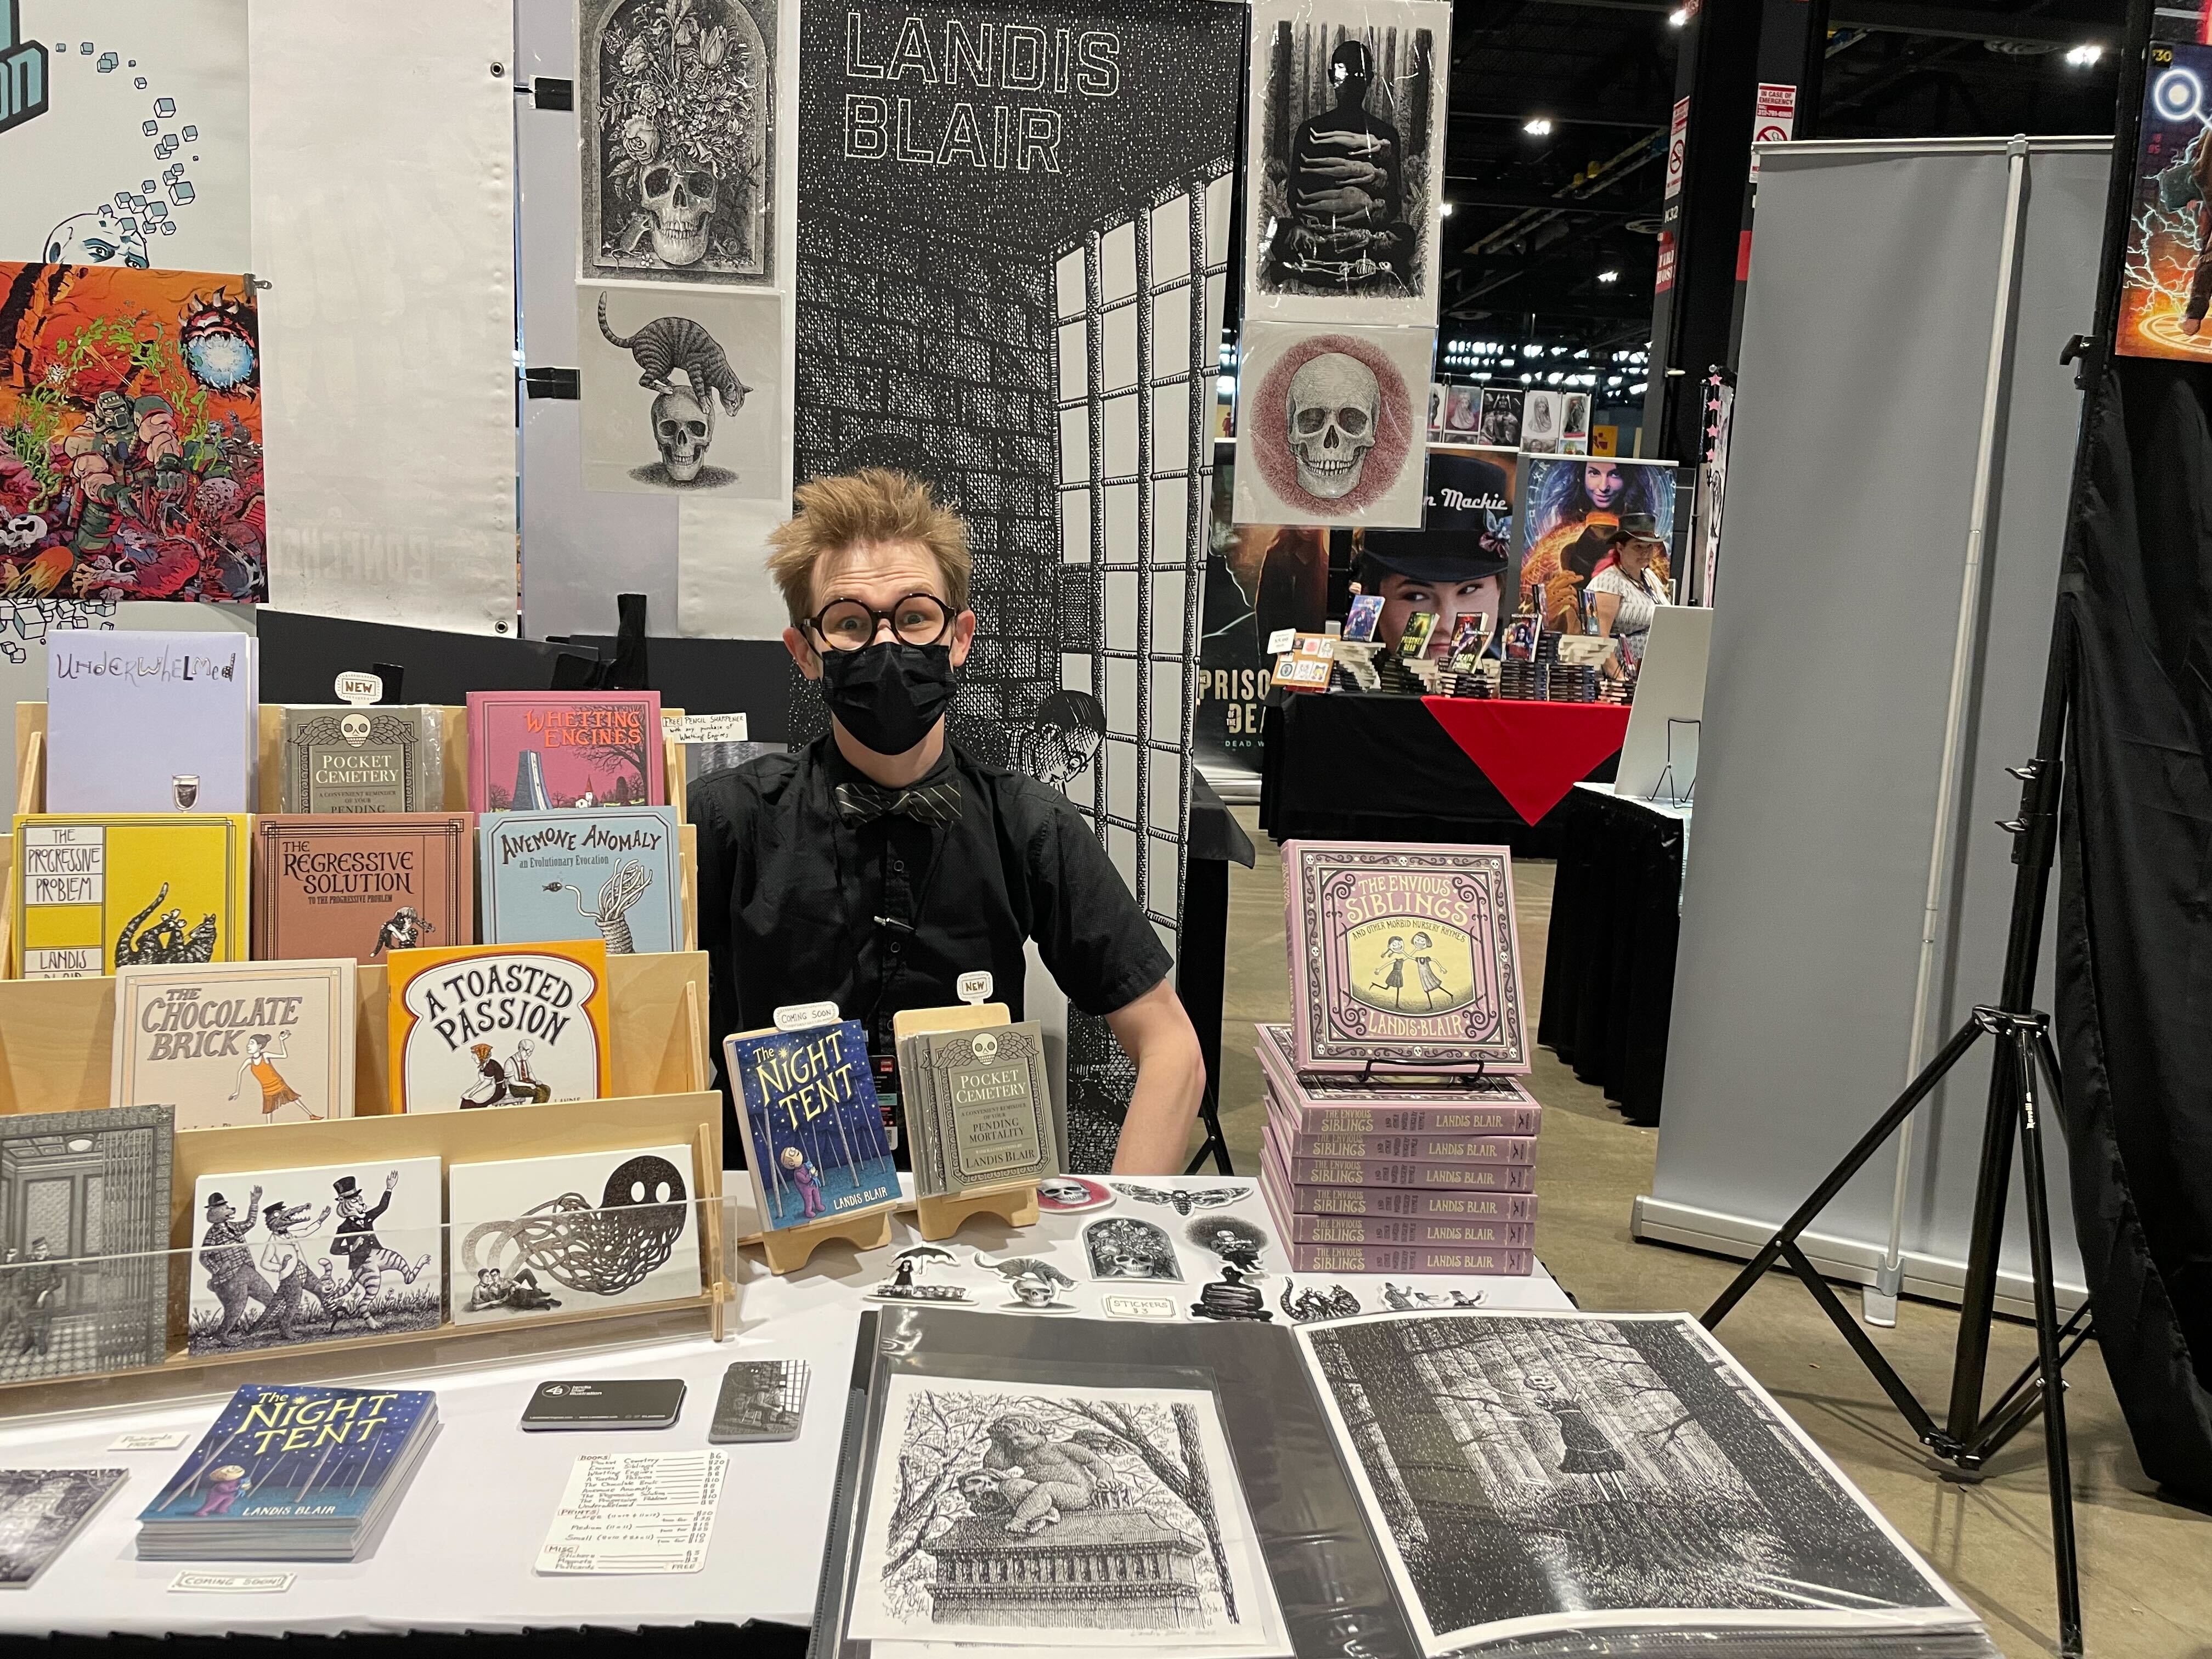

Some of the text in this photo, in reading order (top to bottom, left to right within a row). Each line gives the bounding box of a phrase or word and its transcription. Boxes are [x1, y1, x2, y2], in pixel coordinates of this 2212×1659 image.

[847, 12, 1119, 96] LANDIS
[1759, 97, 1793, 105] EMERGENCY
[845, 94, 1061, 173] BLAIR
[1441, 488, 1508, 511] Mackie
[345, 681, 373, 693] NEW
[524, 709, 641, 732] WHETTING
[664, 717, 681, 725] FREE
[544, 727, 641, 748] ENGINES
[323, 755, 392, 769] POCKET
[315, 769, 399, 784] CEMETERY
[331, 804, 386, 813] PENDING
[52, 829, 76, 844] THE
[282, 841, 310, 853] THE
[501, 824, 662, 865] ANEMONE ANOMALY
[28, 848, 101, 873] PROGRESSIVE
[283, 851, 414, 881] REGRESSIVE
[519, 854, 609, 868] an Evolutionary Evocation
[36, 877, 92, 902] PROBLEM
[303, 872, 415, 894] SOLUTION
[1358, 874, 1453, 897] THE ENVIOUS
[317, 896, 328, 905] THE
[329, 895, 366, 904] PROGRESSIVE
[366, 894, 393, 903] PROBLEM
[1345, 892, 1469, 926] SIBLINGS
[1352, 919, 1466, 943] AND OTHER MORBID NURSERY RHYMES
[40, 950, 87, 970] LANDIS
[425, 964, 573, 1022] A TOASTED
[965, 981, 985, 992] NEW
[166, 988, 202, 1001] THE
[142, 996, 303, 1033] CHOCOLATE
[781, 1009, 832, 1024] COMING SOON
[433, 997, 571, 1052] PASSION
[146, 1029, 246, 1061] BRICK
[753, 1046, 775, 1064] The
[960, 1069, 1020, 1090] POCKET
[778, 1063, 853, 1131] TENT
[956, 1082, 1026, 1104] CEMETERY
[966, 1106, 999, 1116] CONVENIENT
[1000, 1103, 1027, 1111] REMINDER
[1325, 1109, 1372, 1119] THE ENVIOUS
[973, 1117, 1019, 1132] PENDING
[1321, 1119, 1374, 1132] SIBLINGS
[1436, 1115, 1471, 1127] LANDIS
[1473, 1115, 1503, 1128] BLAIR
[969, 1126, 1025, 1144] MORTALITY
[1316, 1134, 1331, 1143] THE
[1312, 1142, 1366, 1156] SIBLINGS
[1429, 1142, 1464, 1155] LANDIS
[1466, 1143, 1498, 1157] BLAIR
[966, 1149, 1035, 1169] LANDIS BLAIR
[1314, 1160, 1361, 1171] THE ENVIOUS
[1311, 1169, 1364, 1183] SIBLINGS
[1426, 1170, 1462, 1183] LANDIS
[1464, 1171, 1495, 1184] BLAIR
[833, 1186, 888, 1210] LANDIS BLAIR
[1317, 1189, 1364, 1200] THE ENVIOUS
[1313, 1198, 1366, 1213] SIBLINGS
[1429, 1199, 1465, 1212] LANDIS
[1466, 1201, 1498, 1214] BLAIR
[1316, 1219, 1363, 1229] THE ENVIOUS
[1312, 1228, 1365, 1242] SIBLINGS
[1427, 1227, 1462, 1240] LANDIS
[1464, 1228, 1495, 1240] BLAIR
[1316, 1248, 1363, 1257] THE ENVIOUS
[1313, 1257, 1365, 1271] SIBLINGS
[1427, 1255, 1462, 1267] LANDIS
[1464, 1256, 1494, 1268] BLAIR
[1114, 1300, 1168, 1308] STICKERS
[258, 1392, 289, 1404] The
[254, 1417, 387, 1456] TENT
[242, 1505, 336, 1516] LANDIS BLAIR
